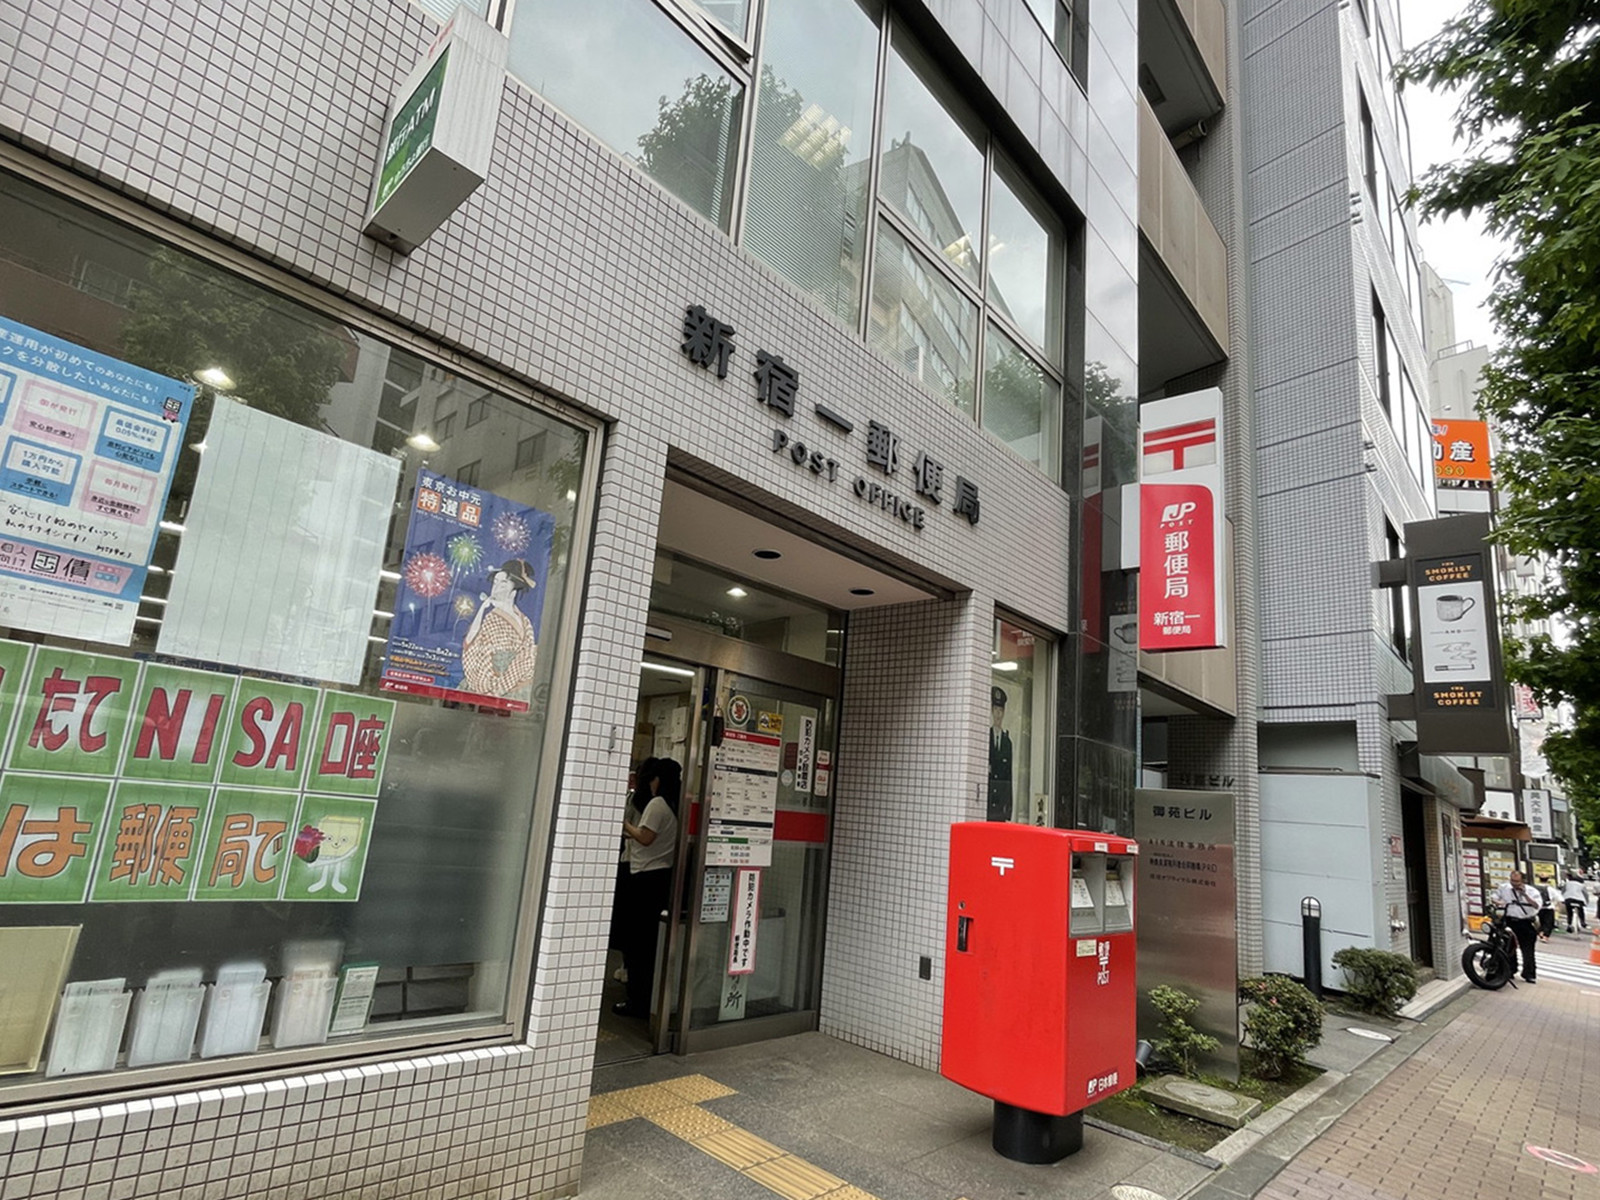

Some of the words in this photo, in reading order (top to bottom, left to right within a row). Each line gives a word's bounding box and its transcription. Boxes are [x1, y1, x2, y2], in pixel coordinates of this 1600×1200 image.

[680, 304, 980, 526] 新宿一郵便局
[421, 476, 482, 505] 東京お中元
[772, 429, 841, 482] POST
[853, 476, 926, 530] OFFICE
[1163, 531, 1189, 600] 郵便局
[1425, 565, 1472, 576] SMOKIST
[1428, 572, 1469, 582] COFFEE
[1153, 610, 1200, 626] 新宿一
[1433, 691, 1482, 699] SMOKIST
[1437, 698, 1479, 706] COFFEE
[0, 665, 386, 780] たてNISA口座
